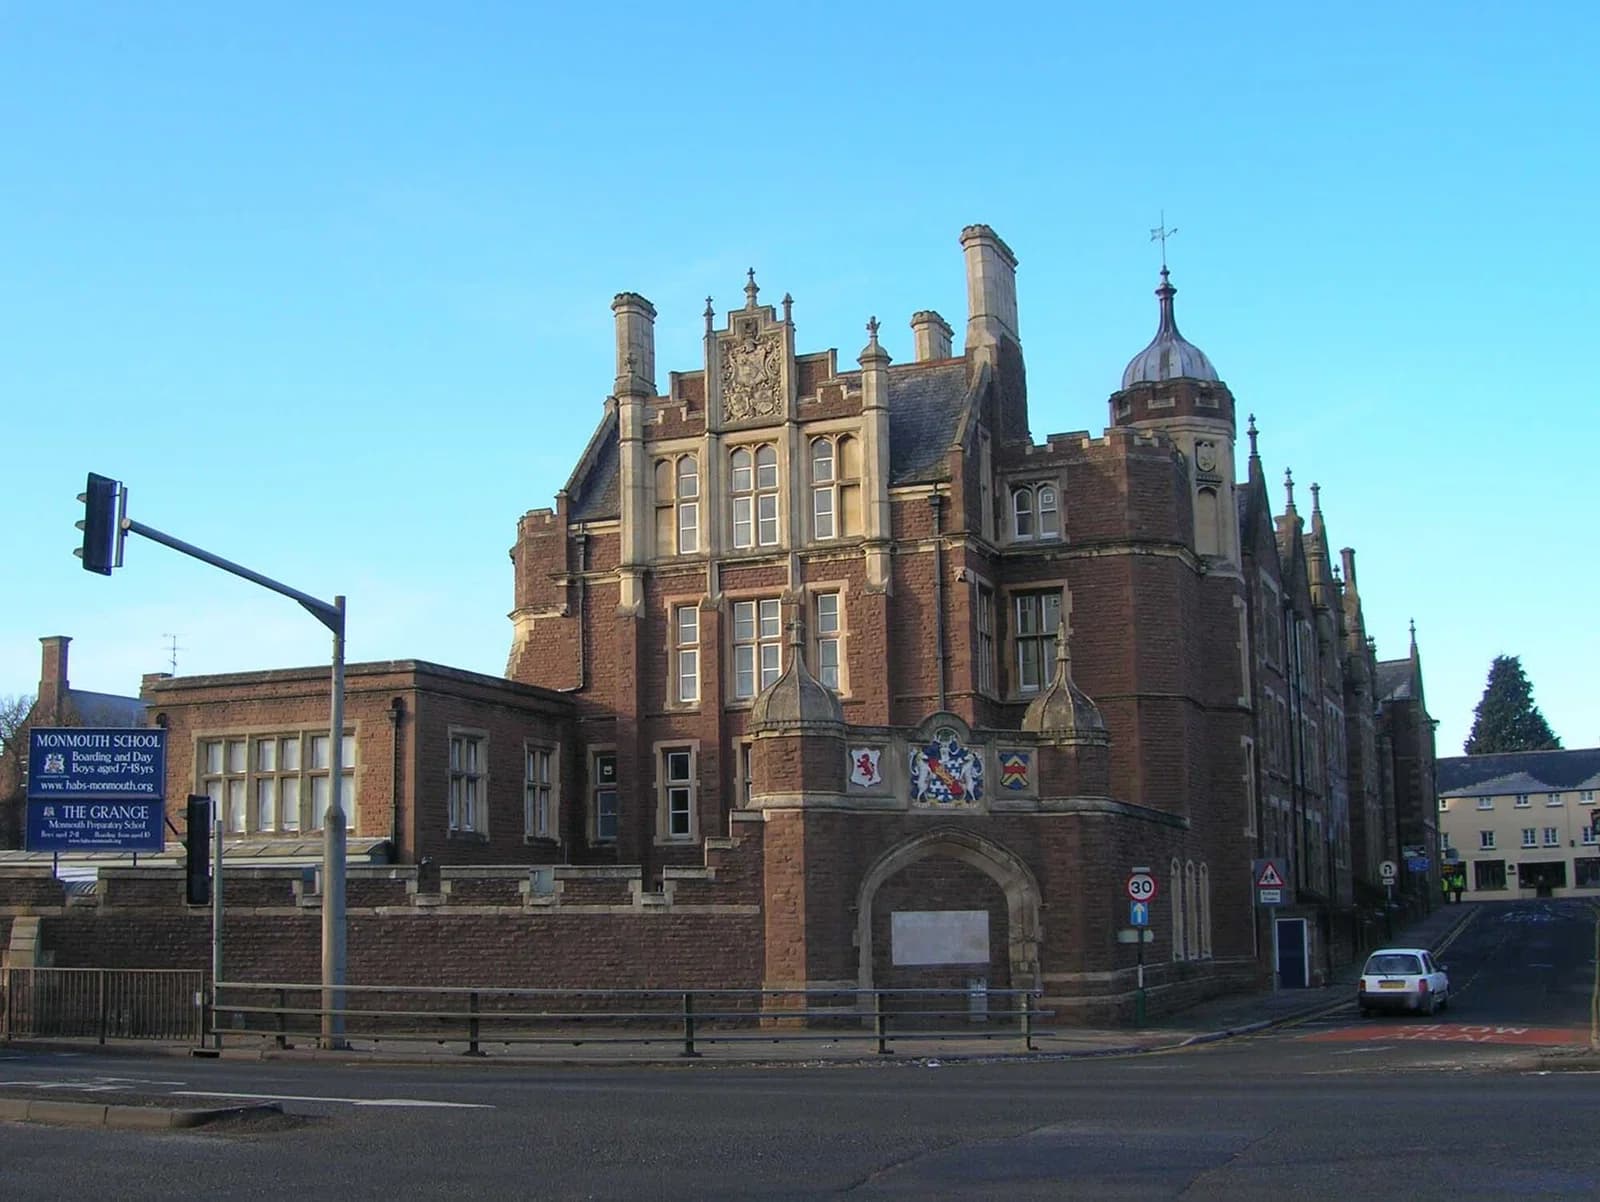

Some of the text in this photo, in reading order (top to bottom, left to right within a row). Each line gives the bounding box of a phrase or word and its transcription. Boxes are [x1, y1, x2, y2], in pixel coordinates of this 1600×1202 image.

[37, 734, 161, 748] MONMOUTH SCHOOL
[72, 751, 153, 763] Boarding and Day
[72, 763, 95, 775] Boys
[97, 763, 119, 775] aged
[63, 805, 149, 819] THE GRANGE
[49, 820, 146, 830] Monmouth Preparatory School
[1131, 881, 1152, 894] 30
